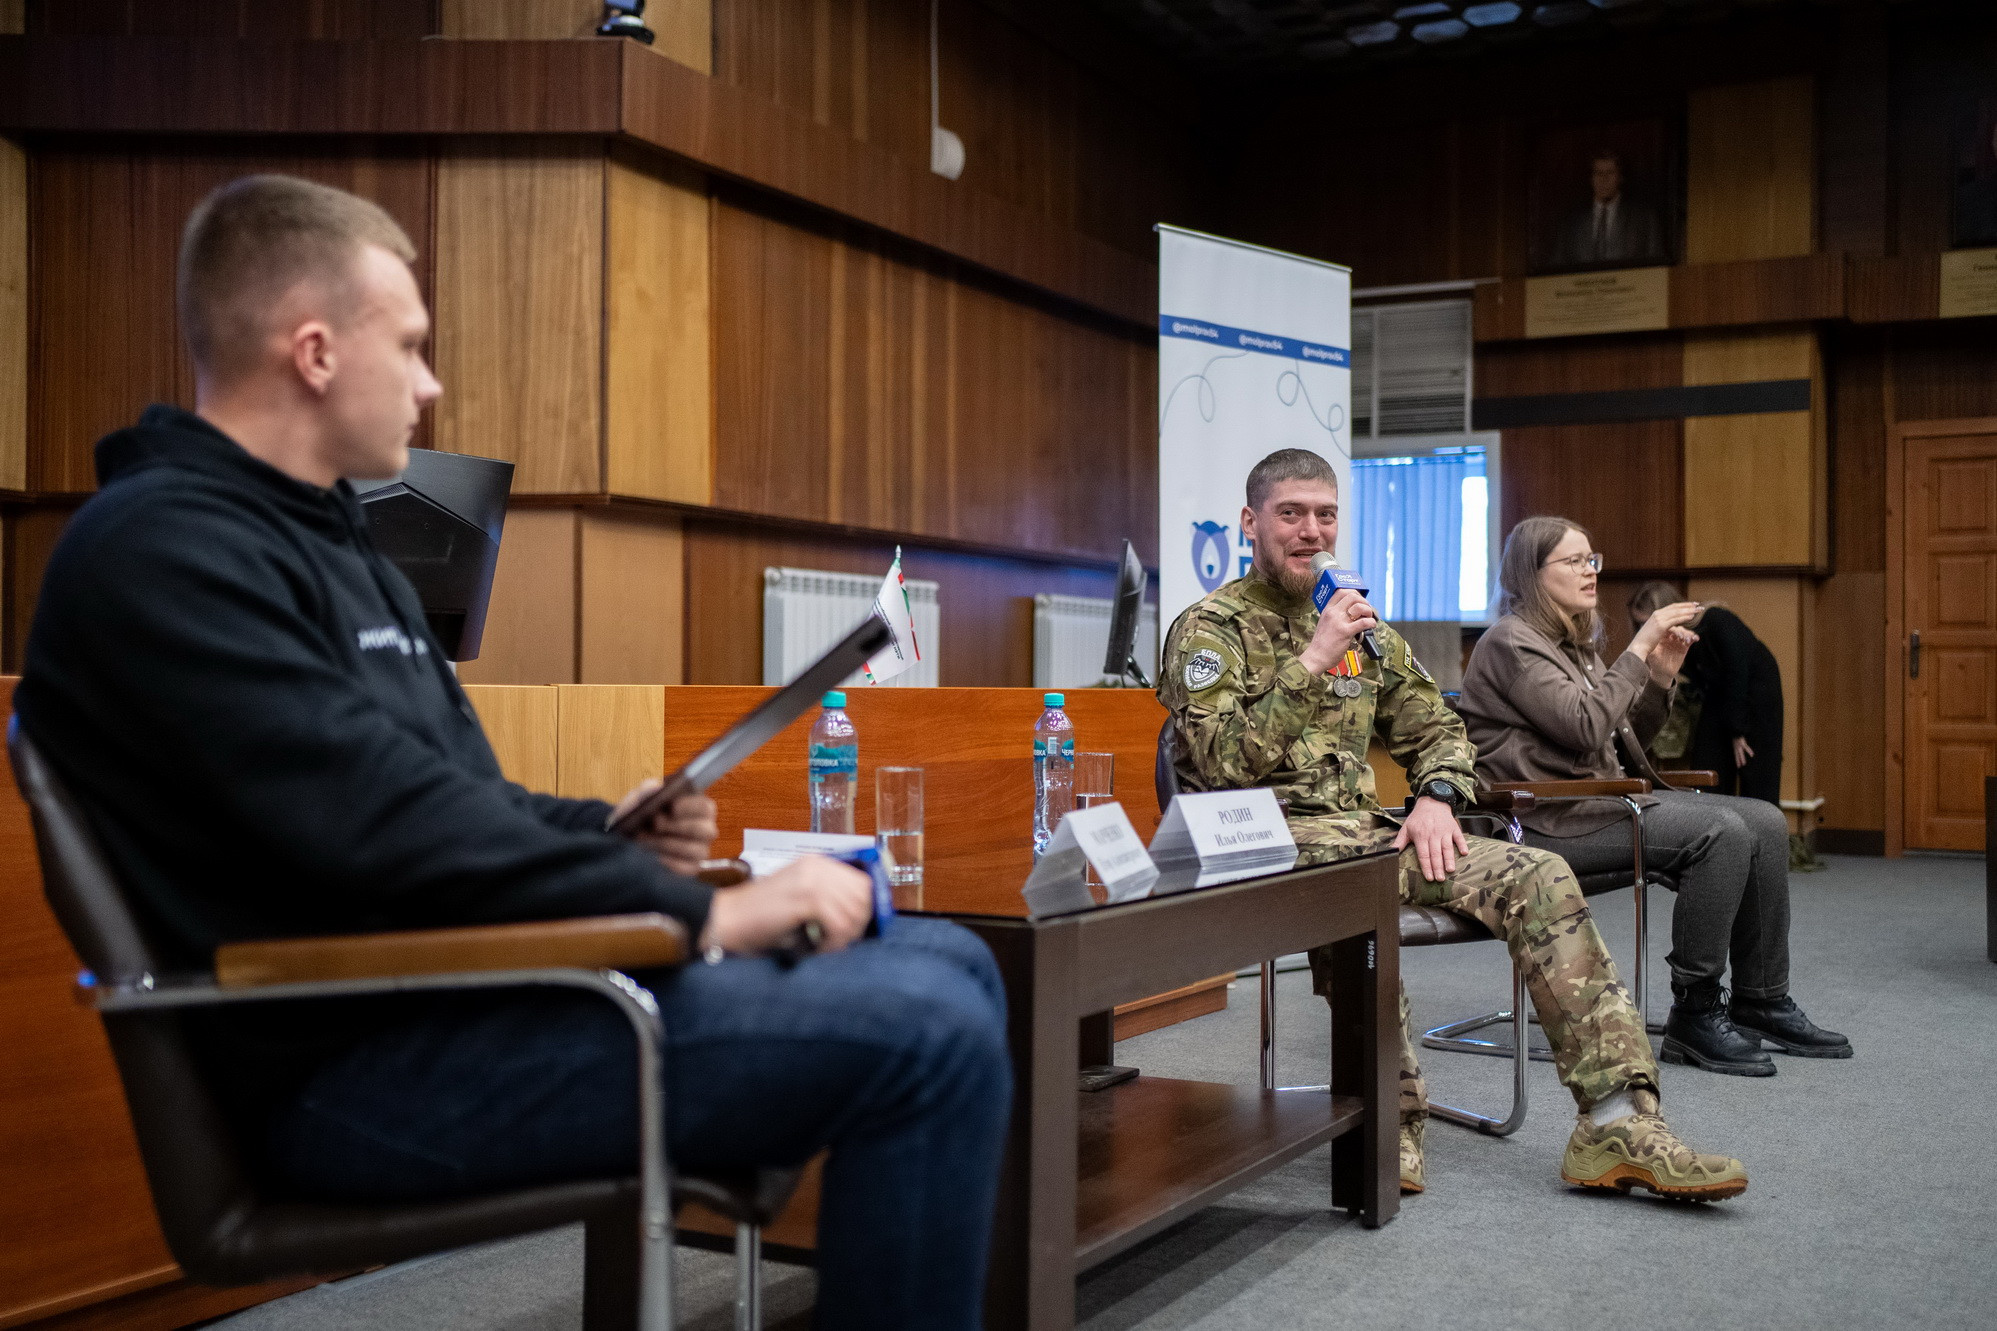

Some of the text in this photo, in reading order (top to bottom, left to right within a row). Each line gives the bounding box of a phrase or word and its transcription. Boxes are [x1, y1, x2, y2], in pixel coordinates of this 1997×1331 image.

[1200, 648, 1221, 661] БПЛА
[1217, 807, 1254, 825] РОДИН
[1213, 829, 1274, 847] Илья Олегович
